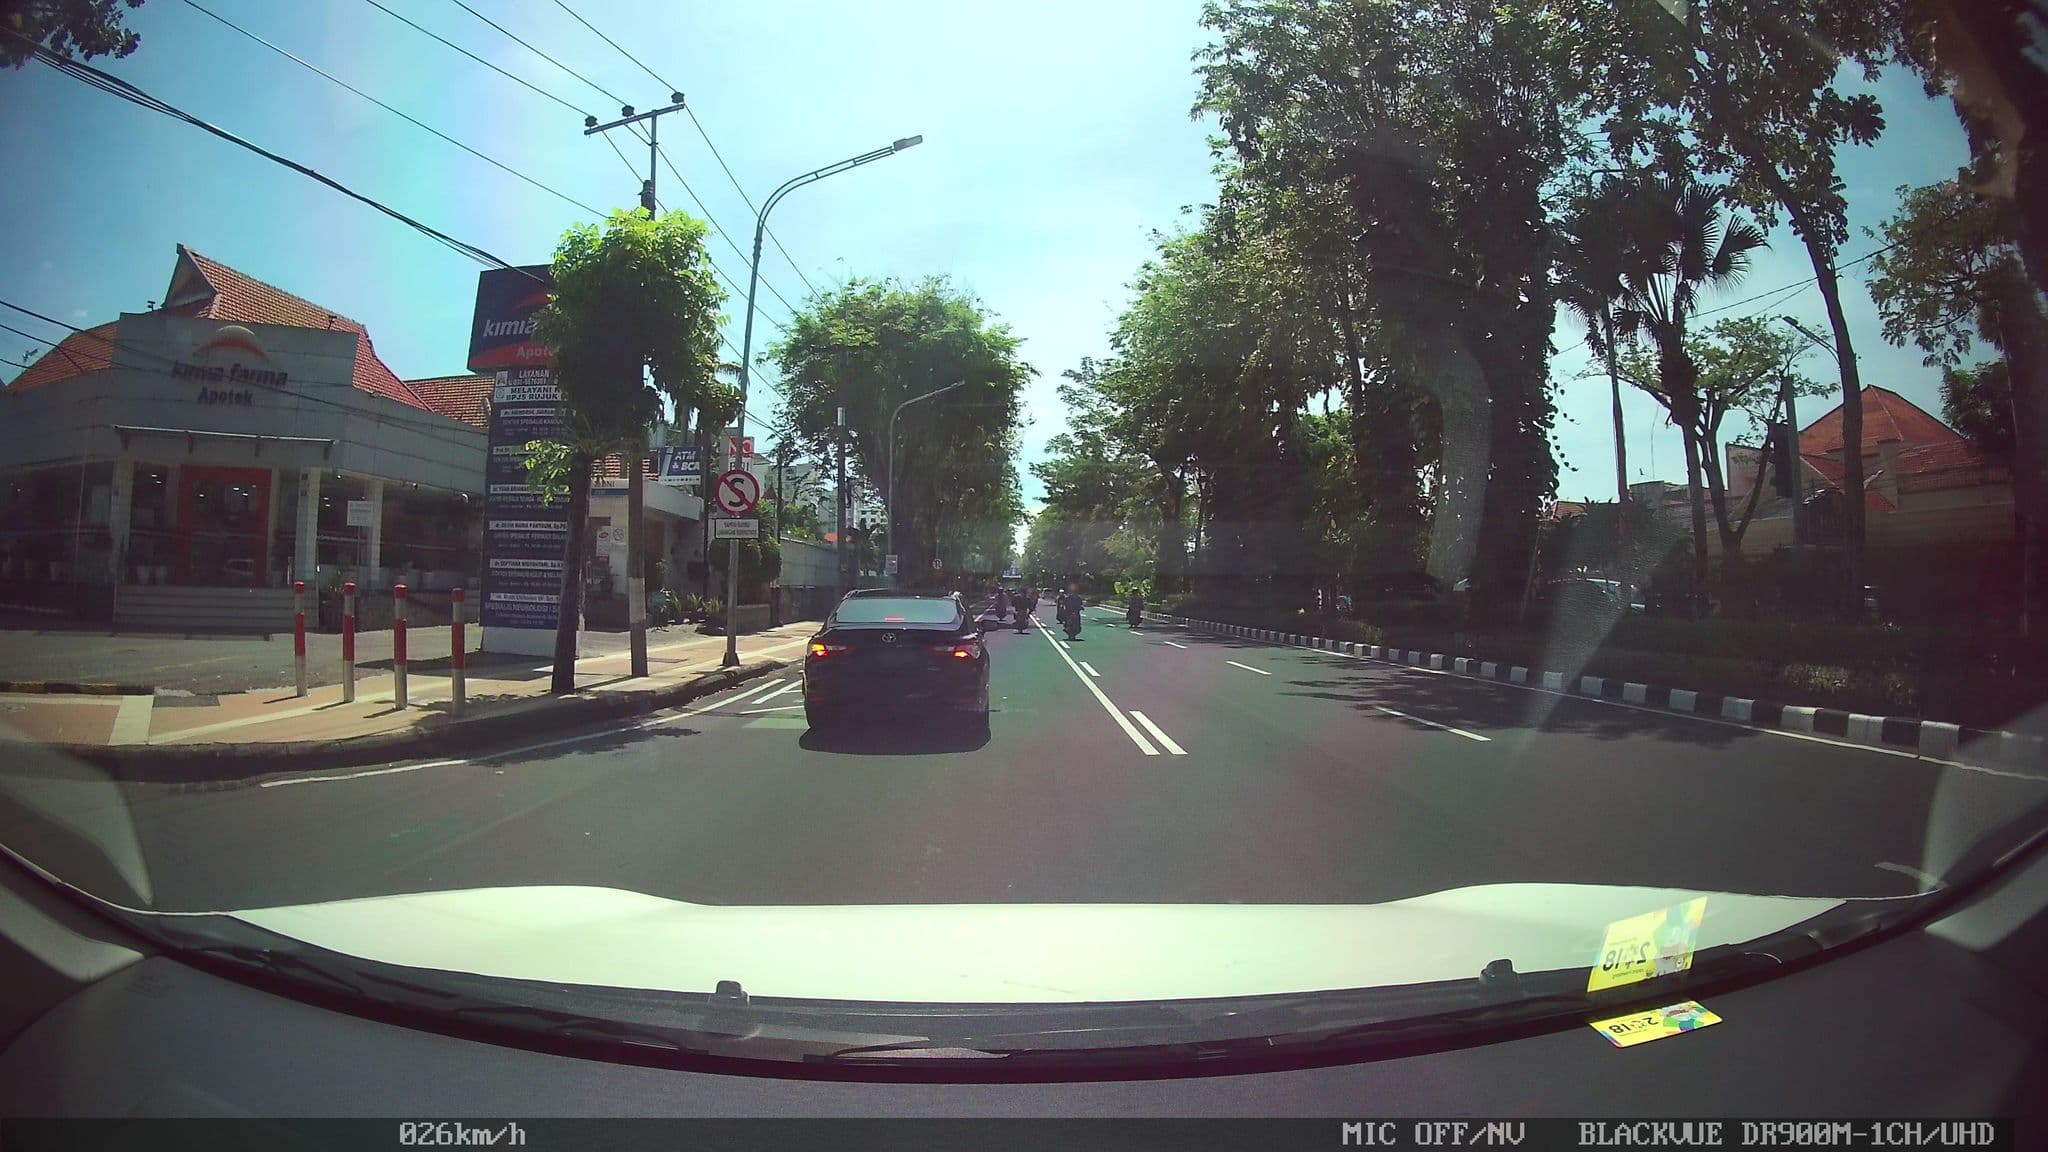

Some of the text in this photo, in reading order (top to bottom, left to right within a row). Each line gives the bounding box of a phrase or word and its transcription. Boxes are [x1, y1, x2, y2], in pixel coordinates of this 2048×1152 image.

[198, 386, 253, 405] Apotek
[675, 450, 697, 461] ATM
[680, 461, 701, 472] BCA
